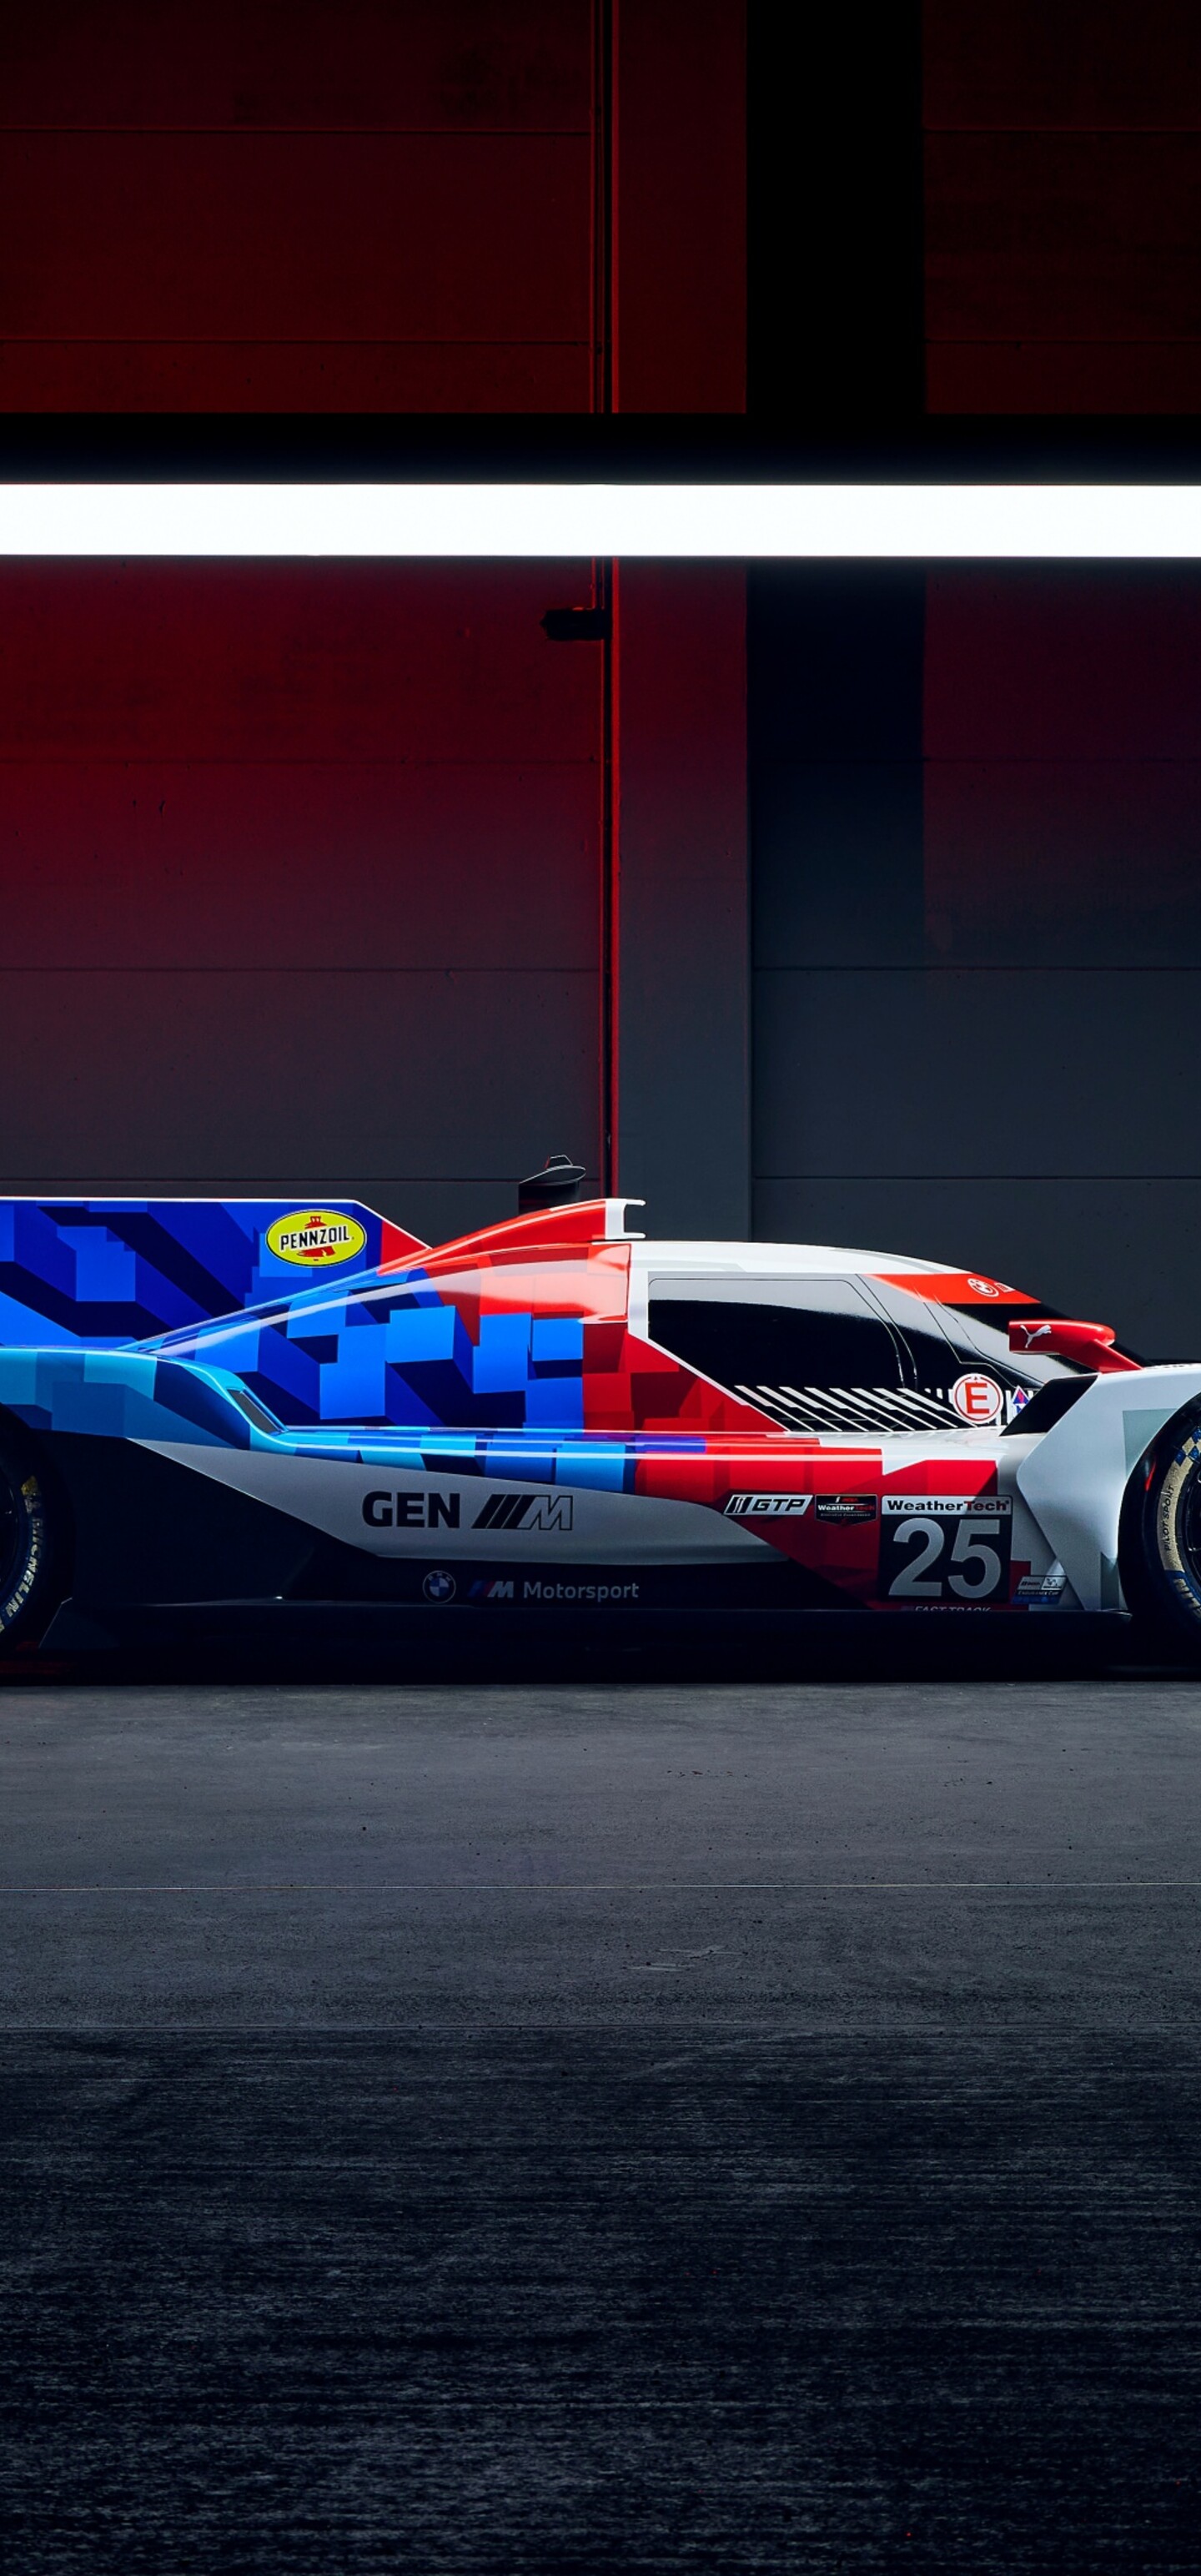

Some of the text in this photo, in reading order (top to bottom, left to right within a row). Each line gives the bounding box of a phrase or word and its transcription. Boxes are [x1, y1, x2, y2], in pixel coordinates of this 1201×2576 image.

[280, 1225, 350, 1250] PENNZOIL
[964, 1382, 990, 1414] E
[362, 1491, 460, 1529] GEN
[751, 1498, 806, 1512] GTP
[887, 1499, 1008, 1512] WeatherTech
[1162, 1520, 1172, 1552] PILOT
[5, 1517, 43, 1618] MICHELIN
[888, 1517, 1002, 1599] 25
[523, 1581, 640, 1602] Motorsport
